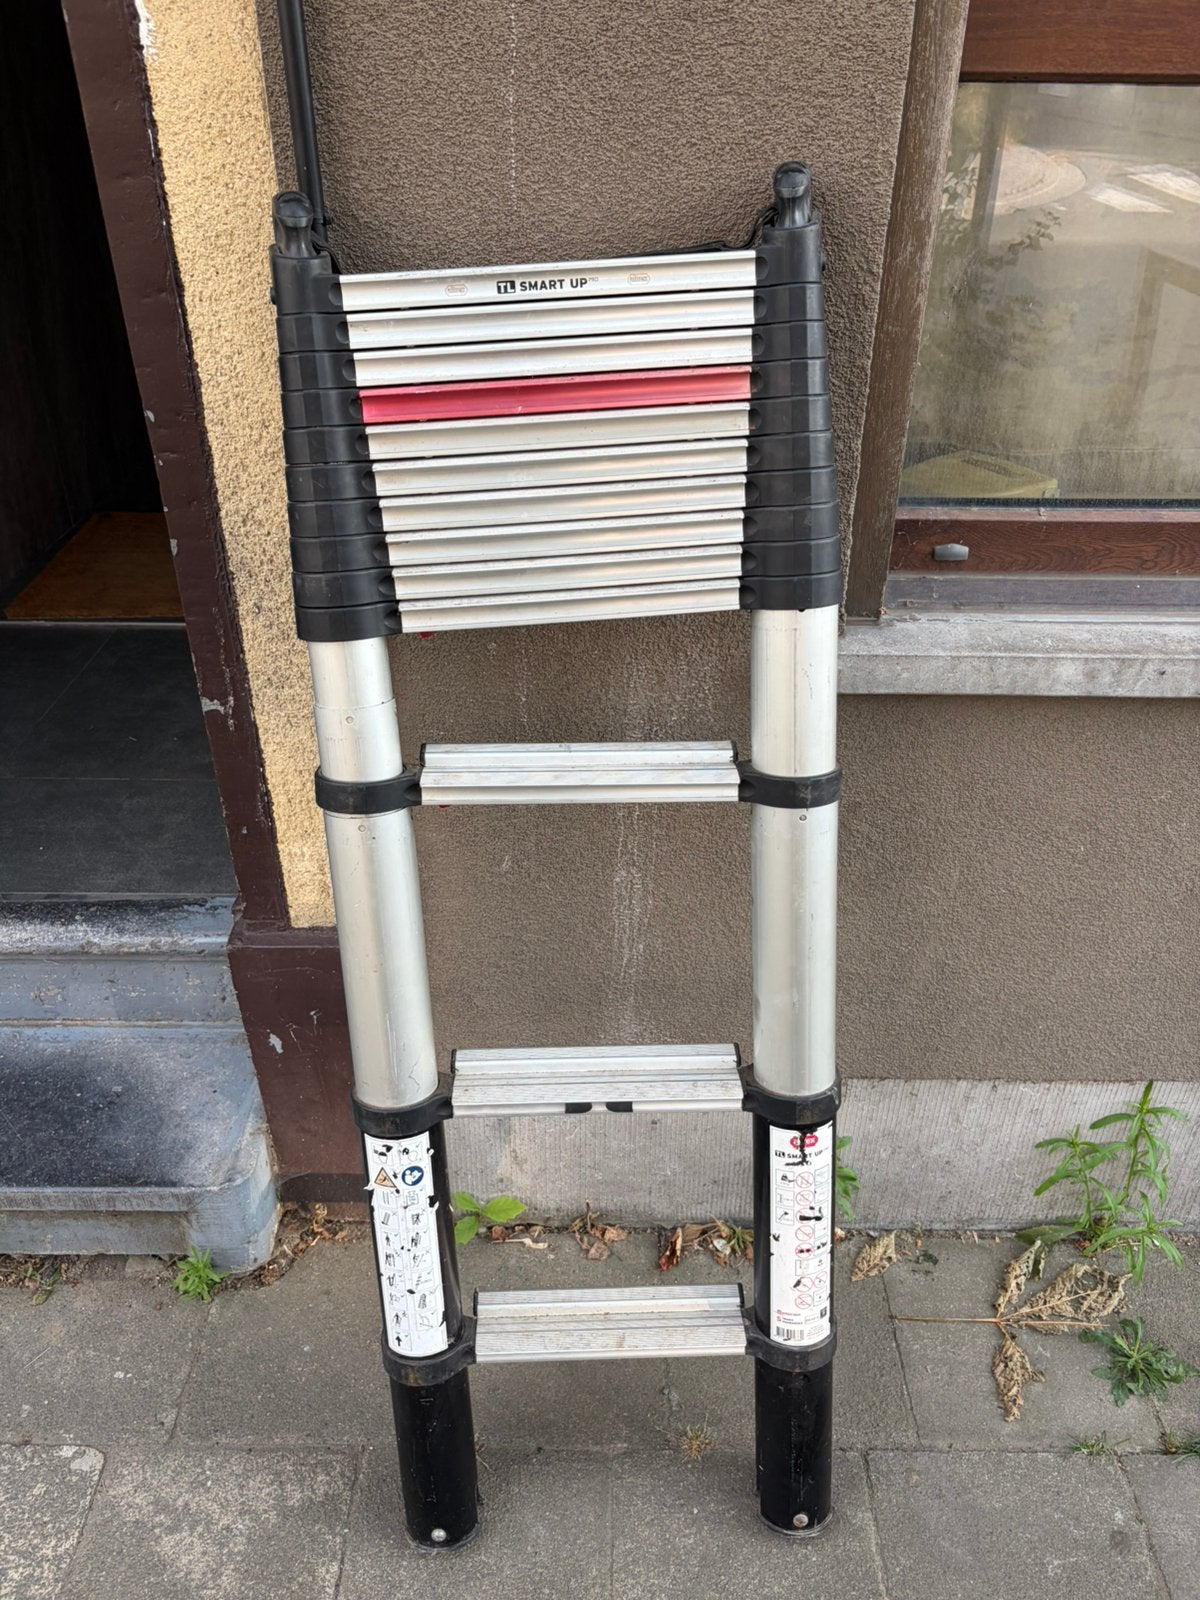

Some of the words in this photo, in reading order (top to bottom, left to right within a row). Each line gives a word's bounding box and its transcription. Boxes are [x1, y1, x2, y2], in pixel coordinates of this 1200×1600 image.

[497, 281, 515, 293] TL
[519, 279, 565, 292] SMART
[570, 277, 588, 288] UP
